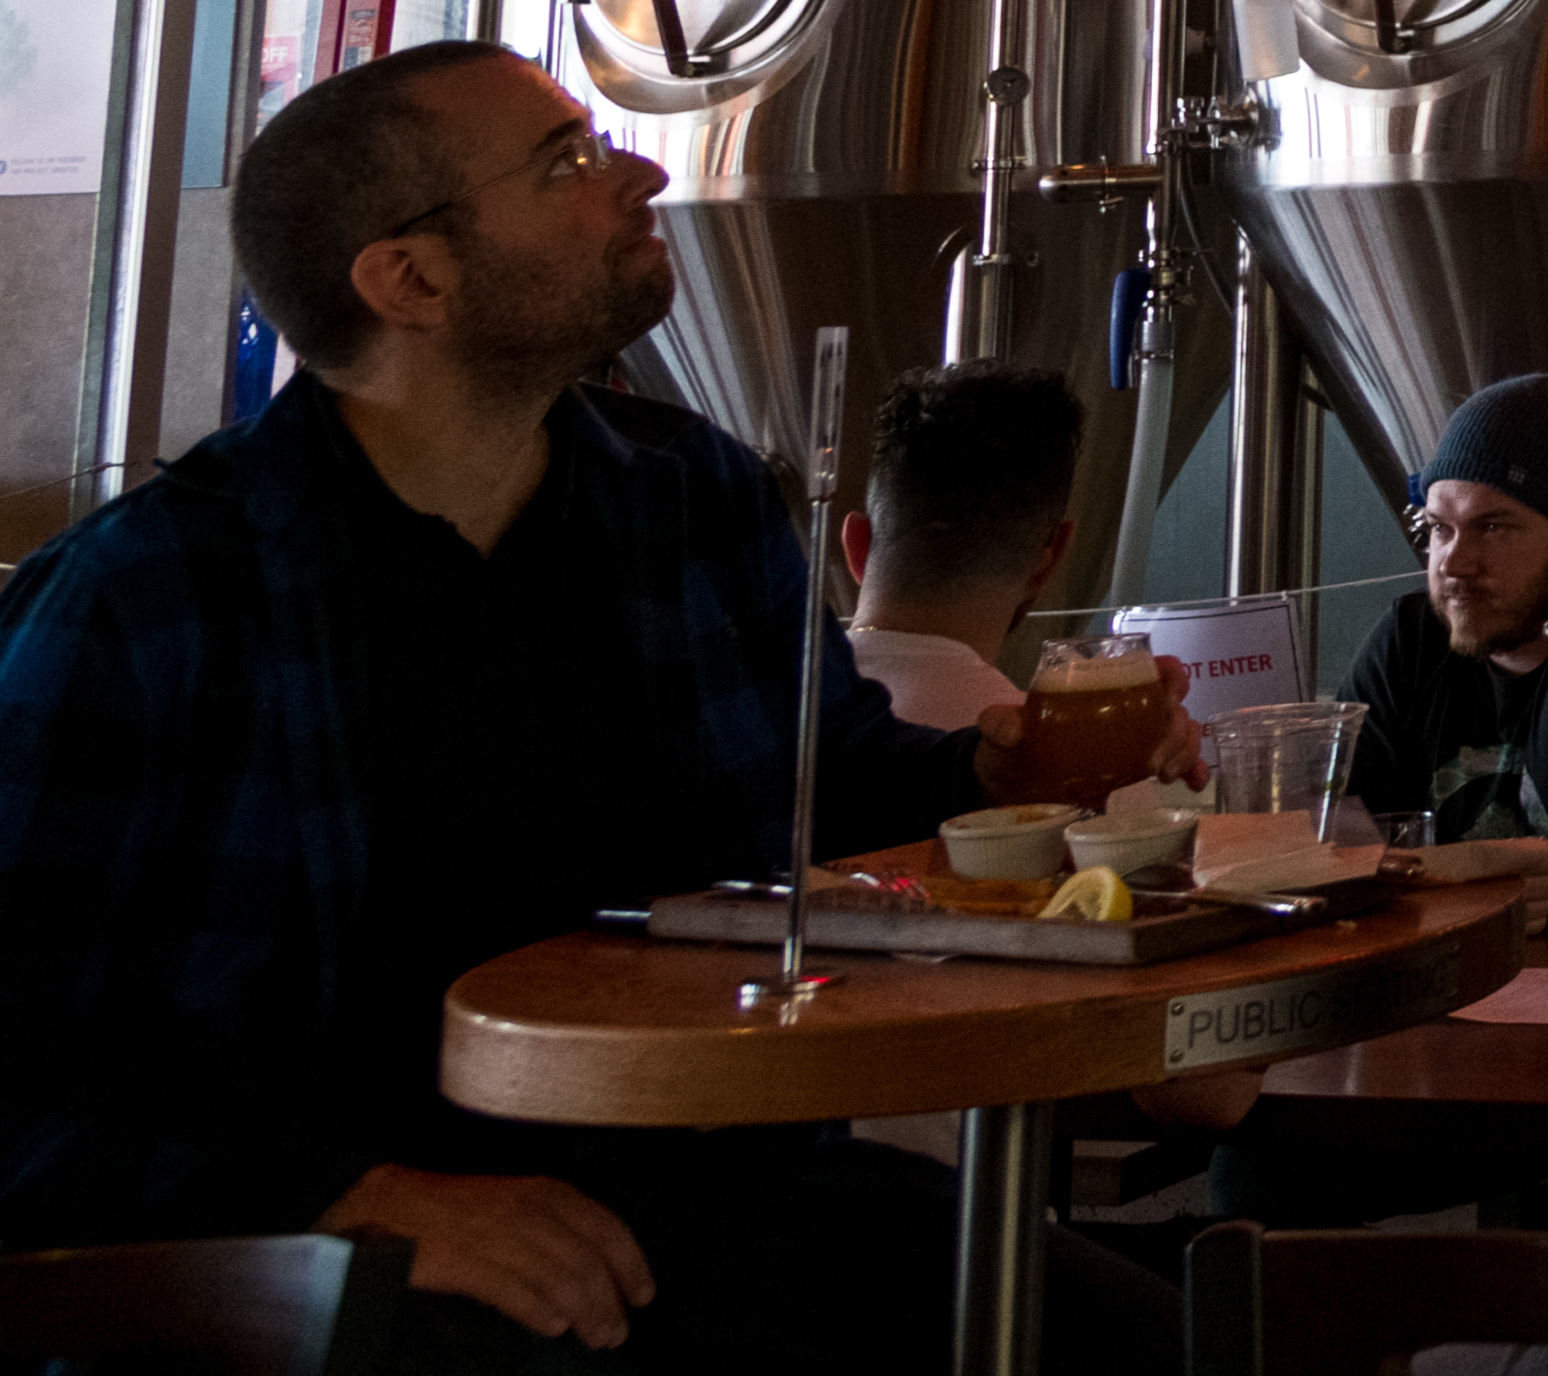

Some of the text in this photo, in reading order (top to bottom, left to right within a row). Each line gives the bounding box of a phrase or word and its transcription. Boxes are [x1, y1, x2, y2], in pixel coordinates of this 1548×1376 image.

[1180, 653, 1273, 679] OT ENTER
[1187, 989, 1322, 1049] PUBLIC
